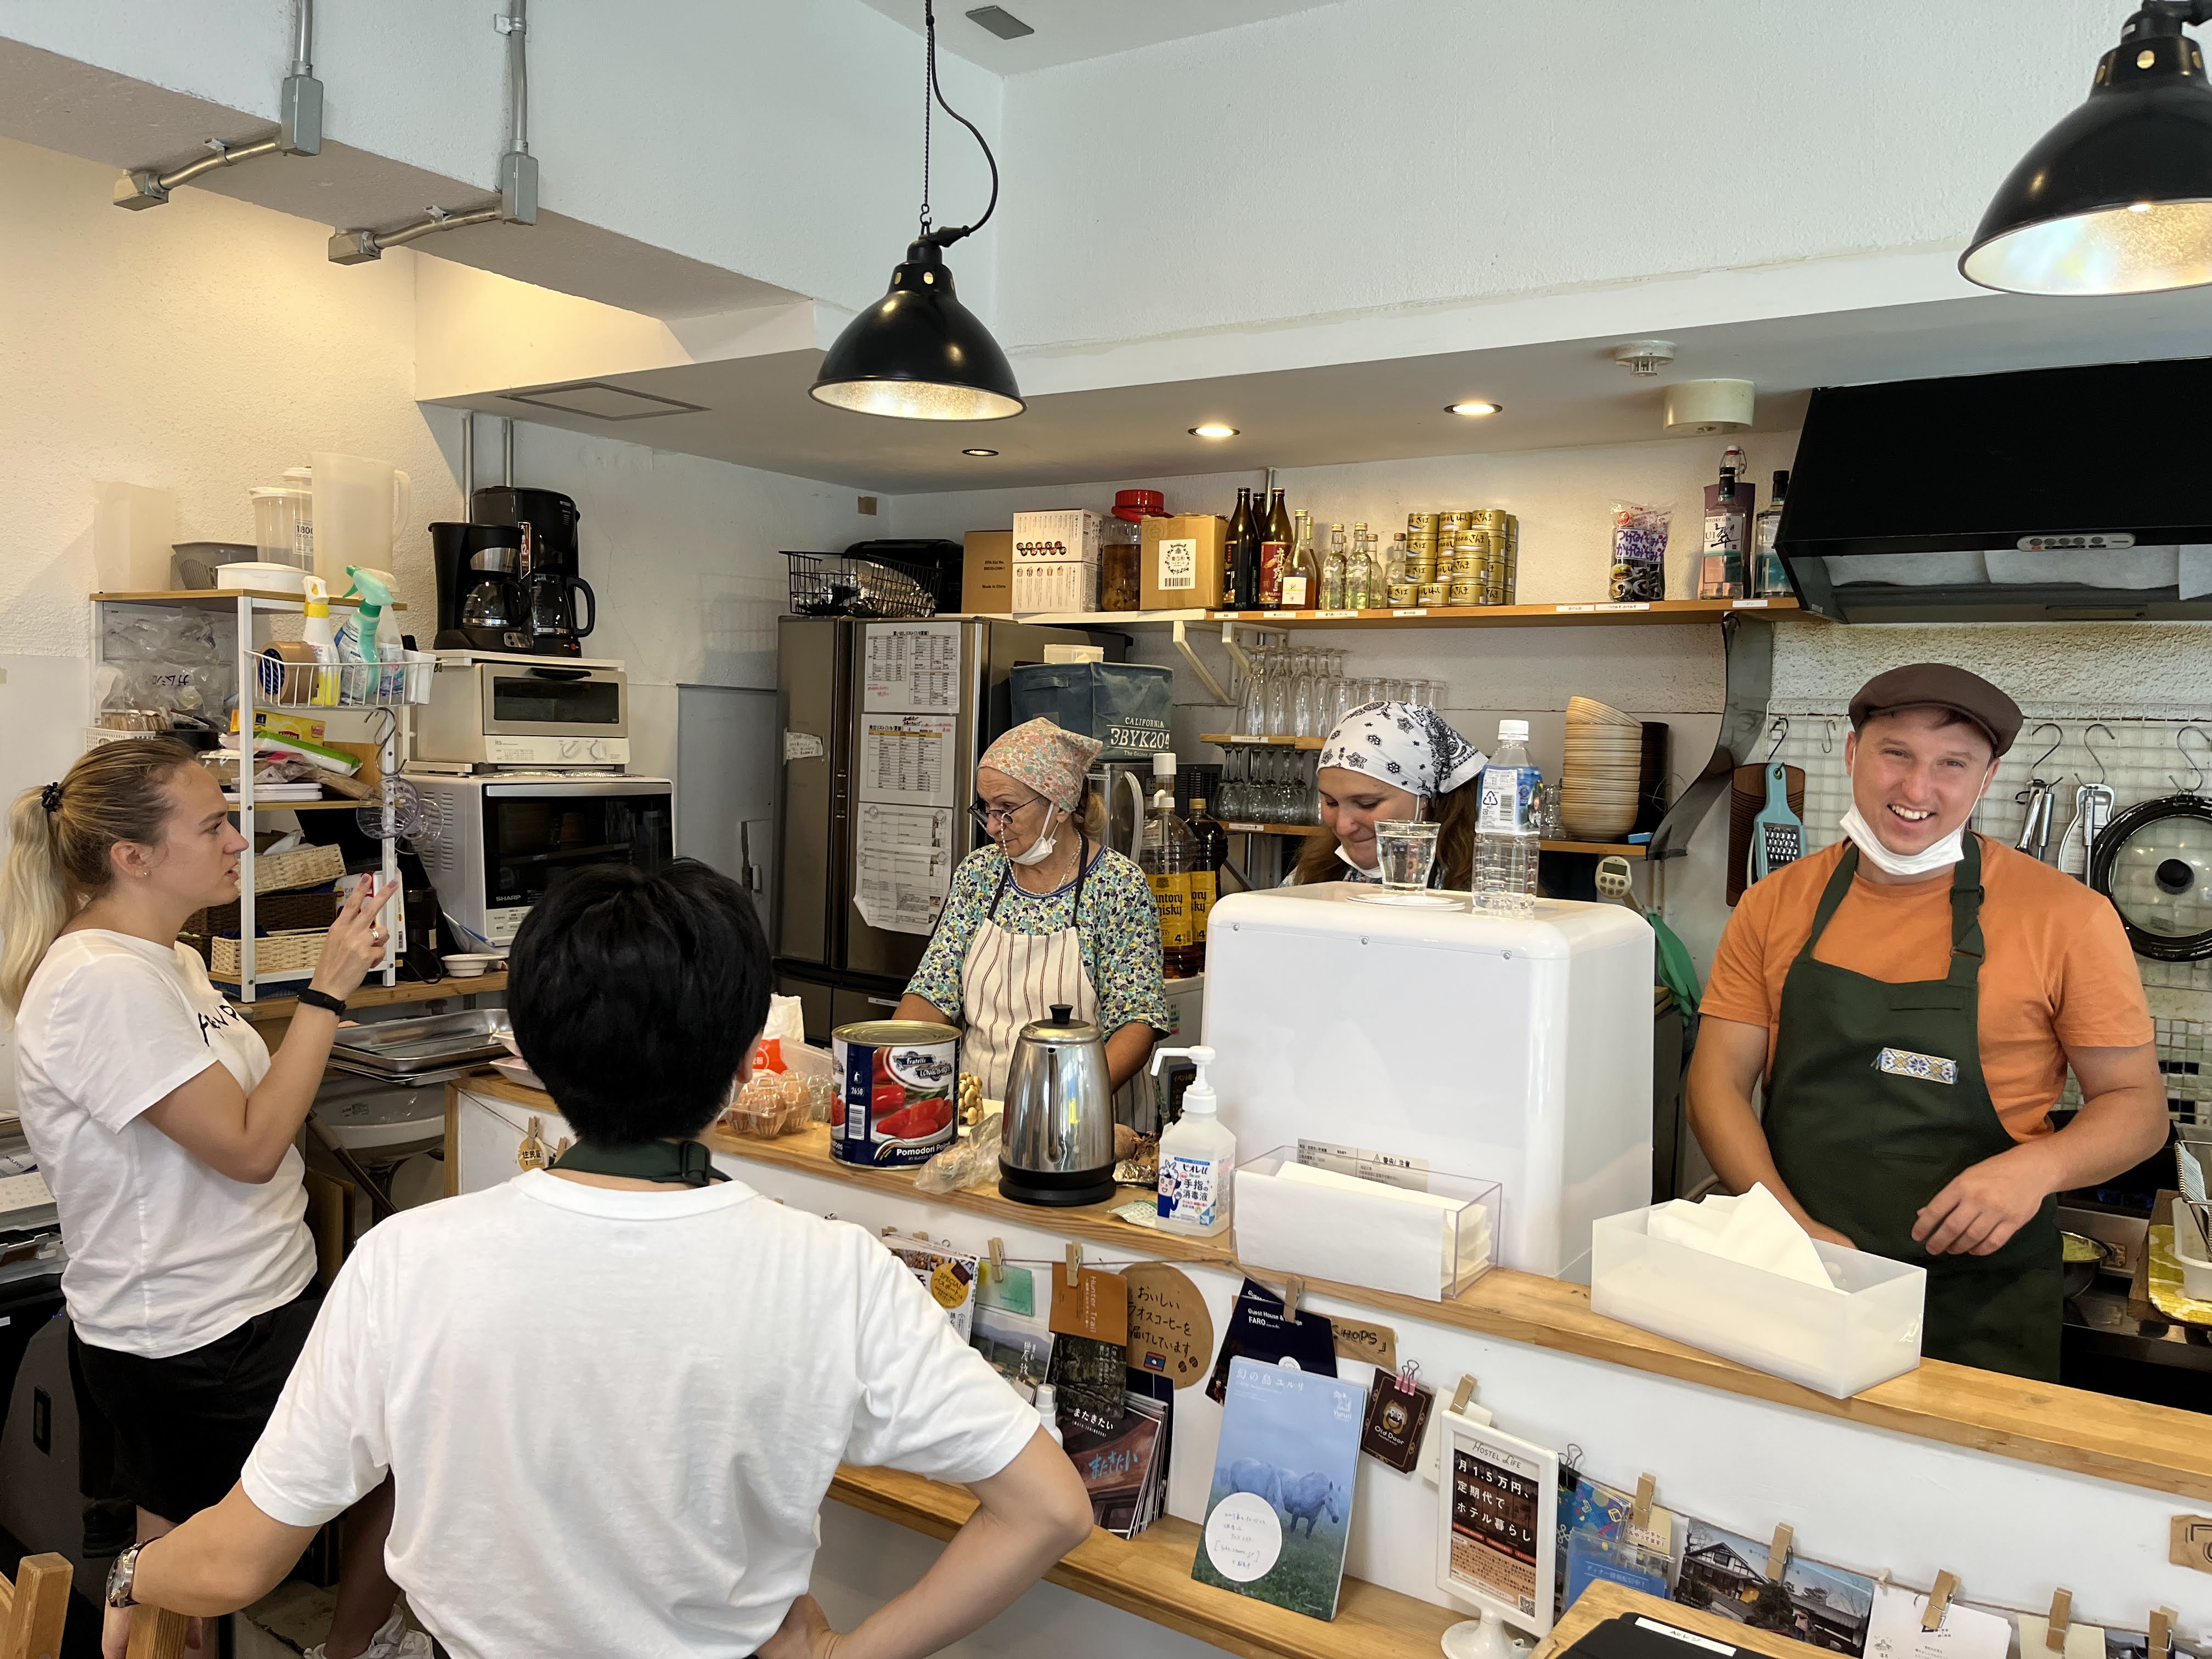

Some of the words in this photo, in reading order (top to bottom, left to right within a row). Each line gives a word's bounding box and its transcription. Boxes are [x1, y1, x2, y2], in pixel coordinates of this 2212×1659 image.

[1125, 717, 1165, 728] CALIFORNIA
[1156, 894, 1183, 904] untory
[1158, 904, 1182, 917] hisky
[1175, 934, 1182, 943] 4
[851, 1086, 864, 1095] 2650
[896, 1146, 935, 1156] Pomodori
[1184, 1179, 1209, 1192] 手指の
[1183, 1189, 1208, 1201] 消毒液
[939, 1272, 962, 1290] SPECIAL
[1138, 1286, 1180, 1309] おいしい
[1248, 1308, 1262, 1317] Guest
[1263, 1311, 1279, 1320] House
[1249, 1316, 1266, 1325] FARO
[1074, 1408, 1113, 1430] またきたい
[1375, 1425, 1387, 1436] Old
[1388, 1432, 1404, 1444] Door
[1088, 1450, 1138, 1480] またきたい
[1457, 1480, 1505, 1509] 定期代で
[1457, 1502, 1531, 1542] ホテル暮らし
